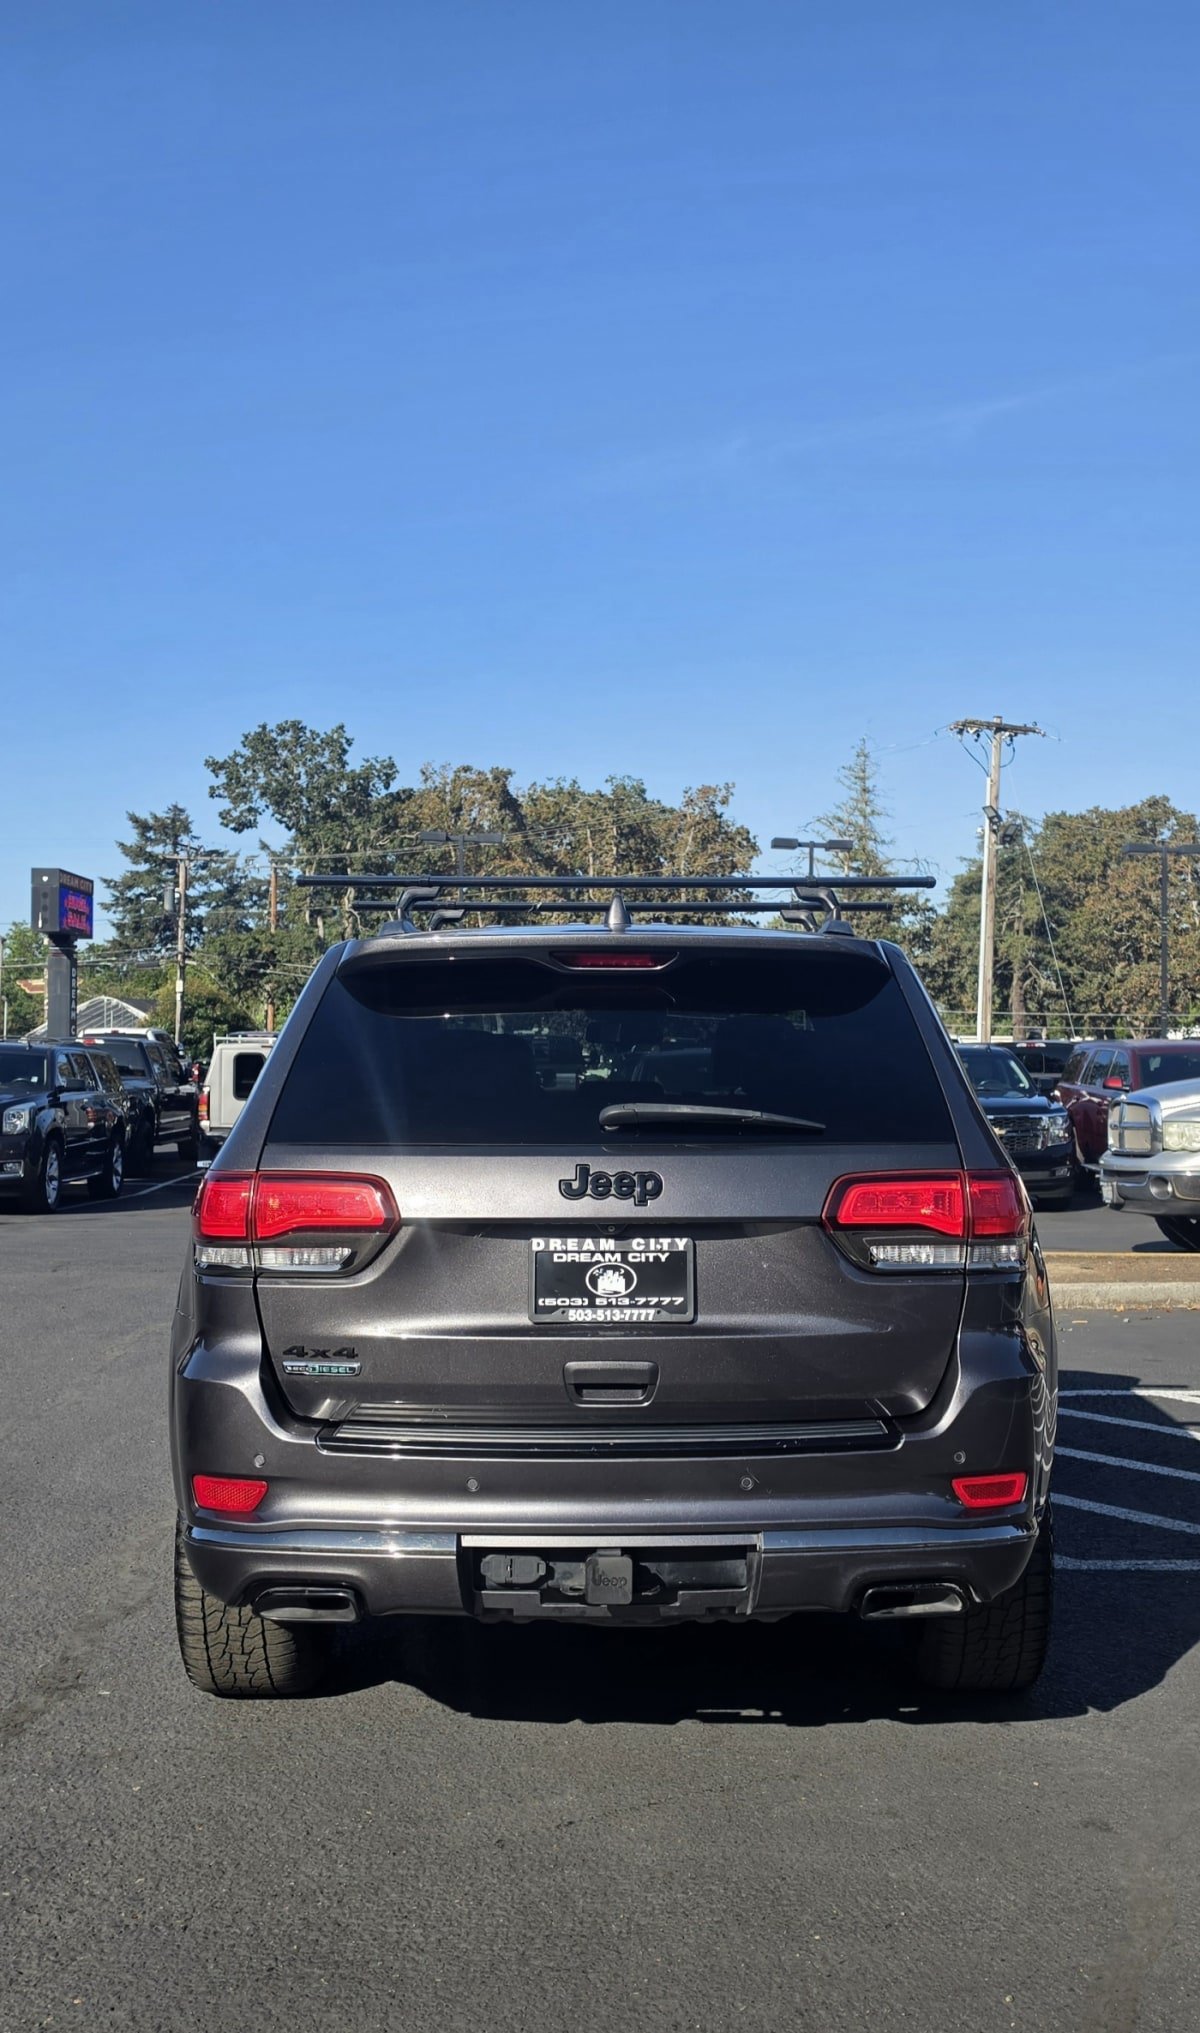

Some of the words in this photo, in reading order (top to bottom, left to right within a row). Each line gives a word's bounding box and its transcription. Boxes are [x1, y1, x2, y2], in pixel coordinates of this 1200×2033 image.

[558, 1163, 664, 1207] Jeep
[531, 1238, 616, 1251] DREAM
[631, 1238, 688, 1251] CITY
[553, 1252, 622, 1263] DREAM
[627, 1252, 670, 1263] CITY
[538, 1297, 589, 1306] (503)
[595, 1296, 684, 1306] 513-7777
[568, 1309, 656, 1322] 503-513-7777
[282, 1345, 359, 1359] 4x4
